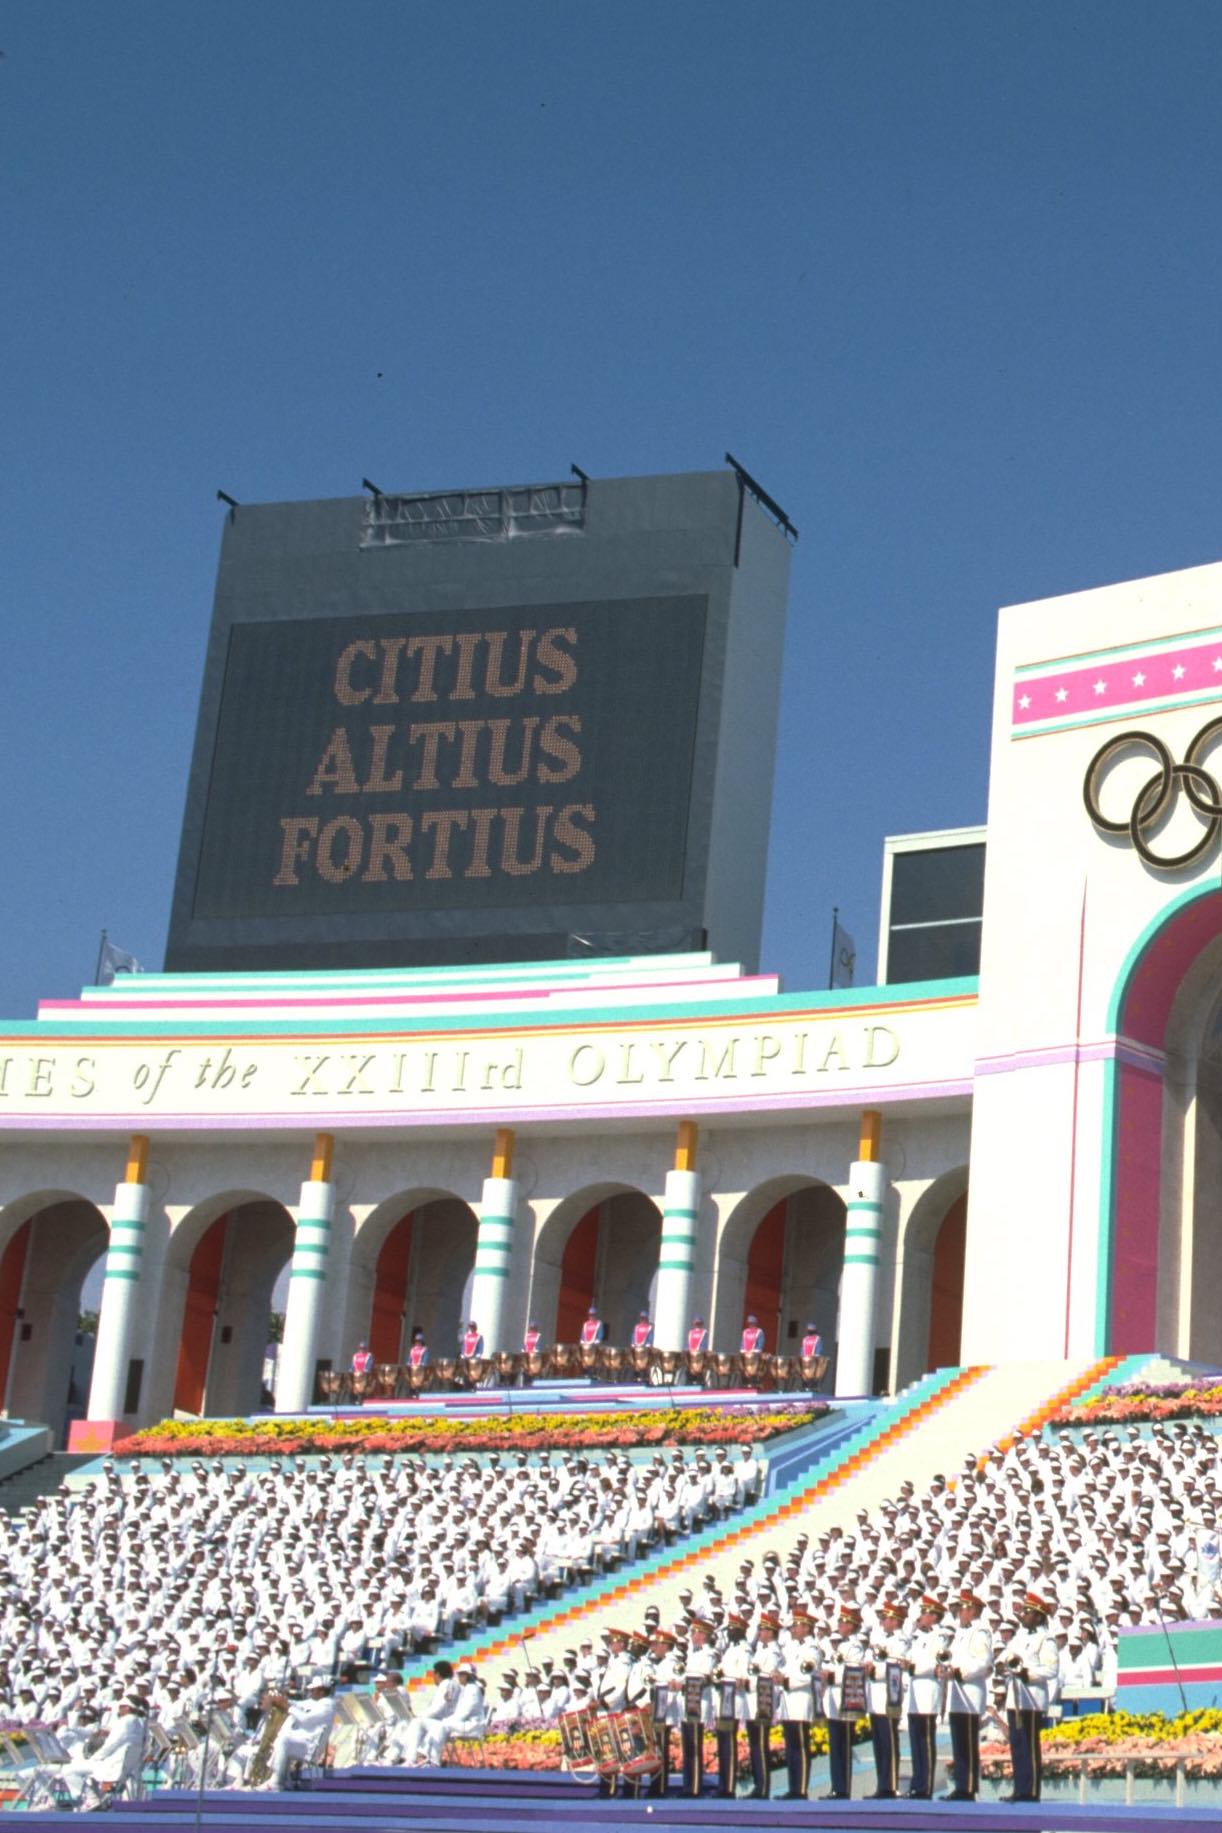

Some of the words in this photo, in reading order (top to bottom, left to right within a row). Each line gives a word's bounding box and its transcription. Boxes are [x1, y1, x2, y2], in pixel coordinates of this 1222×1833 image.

[333, 627, 579, 706] CITIUS
[306, 714, 583, 796] ALTIUS
[272, 803, 597, 886] FORTIUS
[133, 1049, 182, 1106] of
[194, 1048, 259, 1091] the
[290, 1048, 524, 1096] XXIIIrd
[567, 1026, 901, 1088] OLYMPIAD
